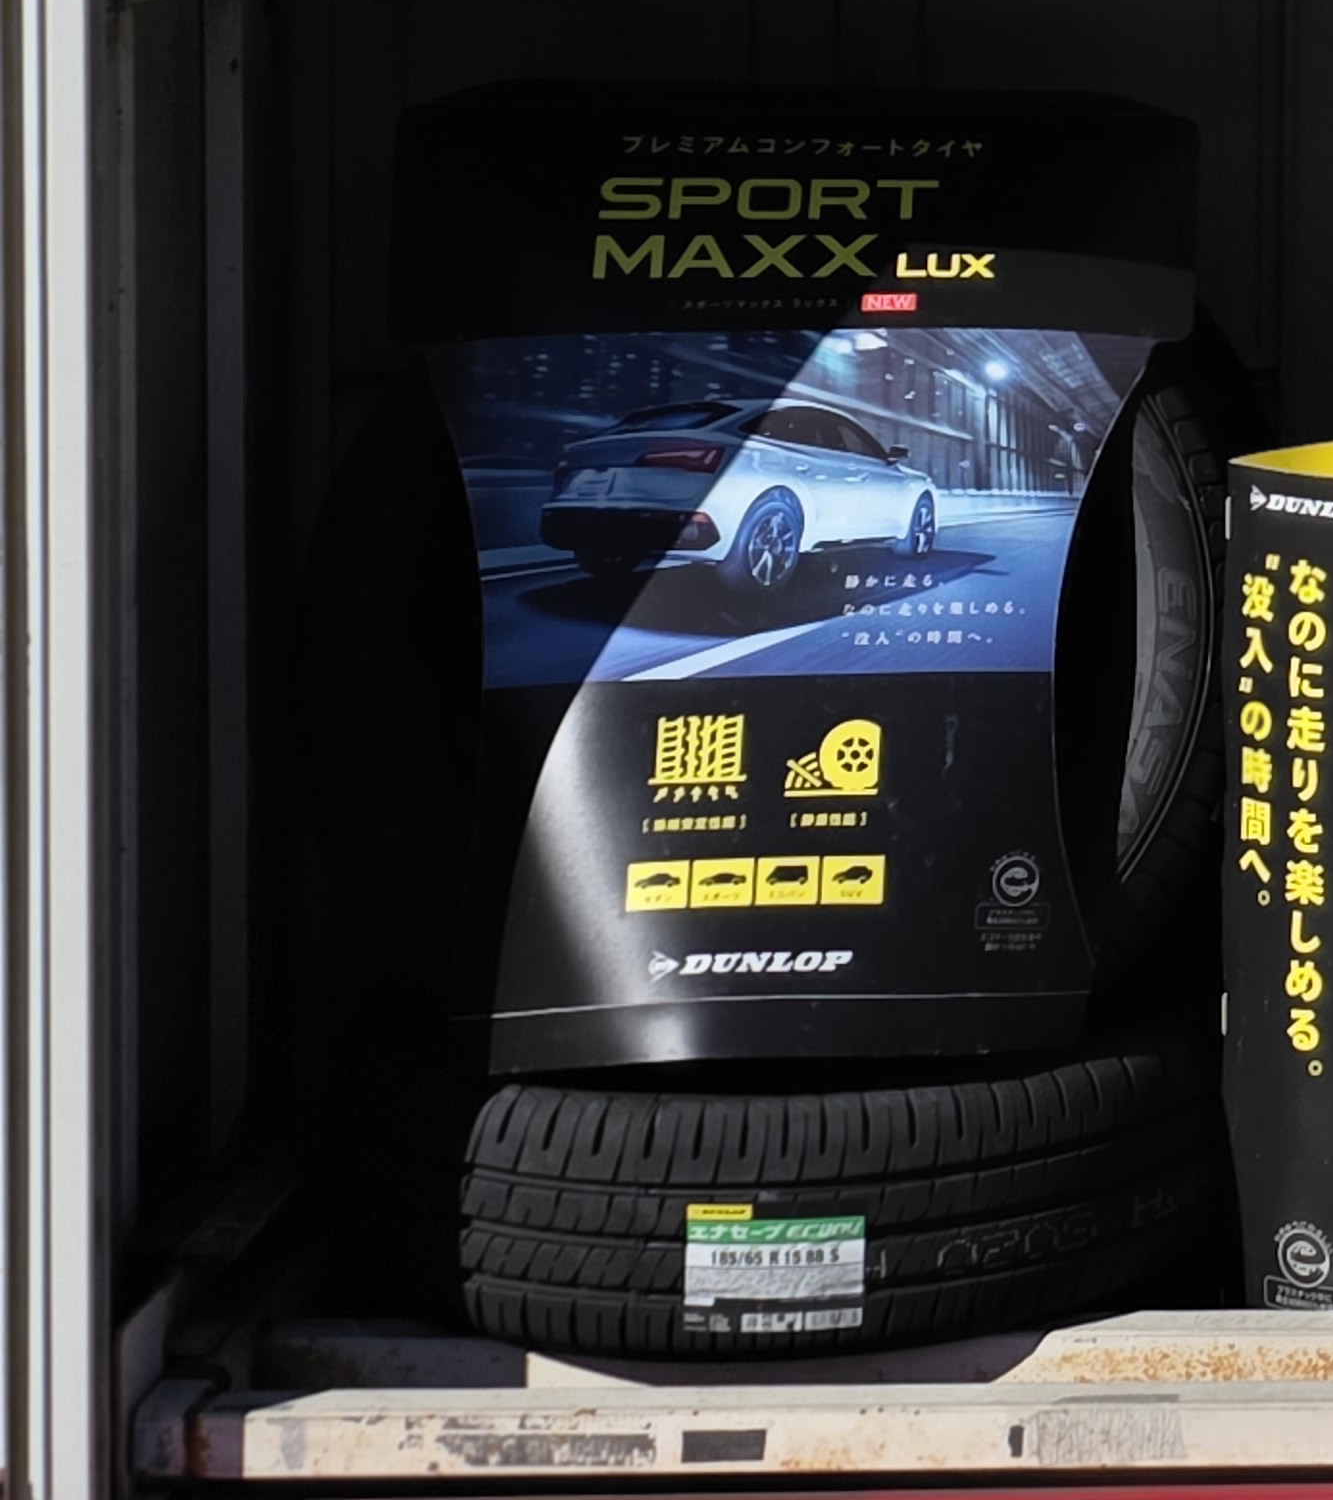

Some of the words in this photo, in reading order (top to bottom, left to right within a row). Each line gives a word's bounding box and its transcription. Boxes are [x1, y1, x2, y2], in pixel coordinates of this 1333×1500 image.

[622, 135, 983, 158] プレミアムコンフォートタイヤ
[597, 177, 940, 220] SPORT
[592, 234, 879, 279] MAXX
[896, 253, 996, 278] LUX
[866, 295, 912, 310] NEW
[1284, 559, 1327, 1078] なのに走りを楽しめる。
[679, 950, 853, 975] DUNLOP
[687, 1223, 784, 1241] エナセーブ
[711, 1251, 763, 1265] 185/65
[785, 1250, 801, 1264] 15
[830, 1248, 840, 1263] S
